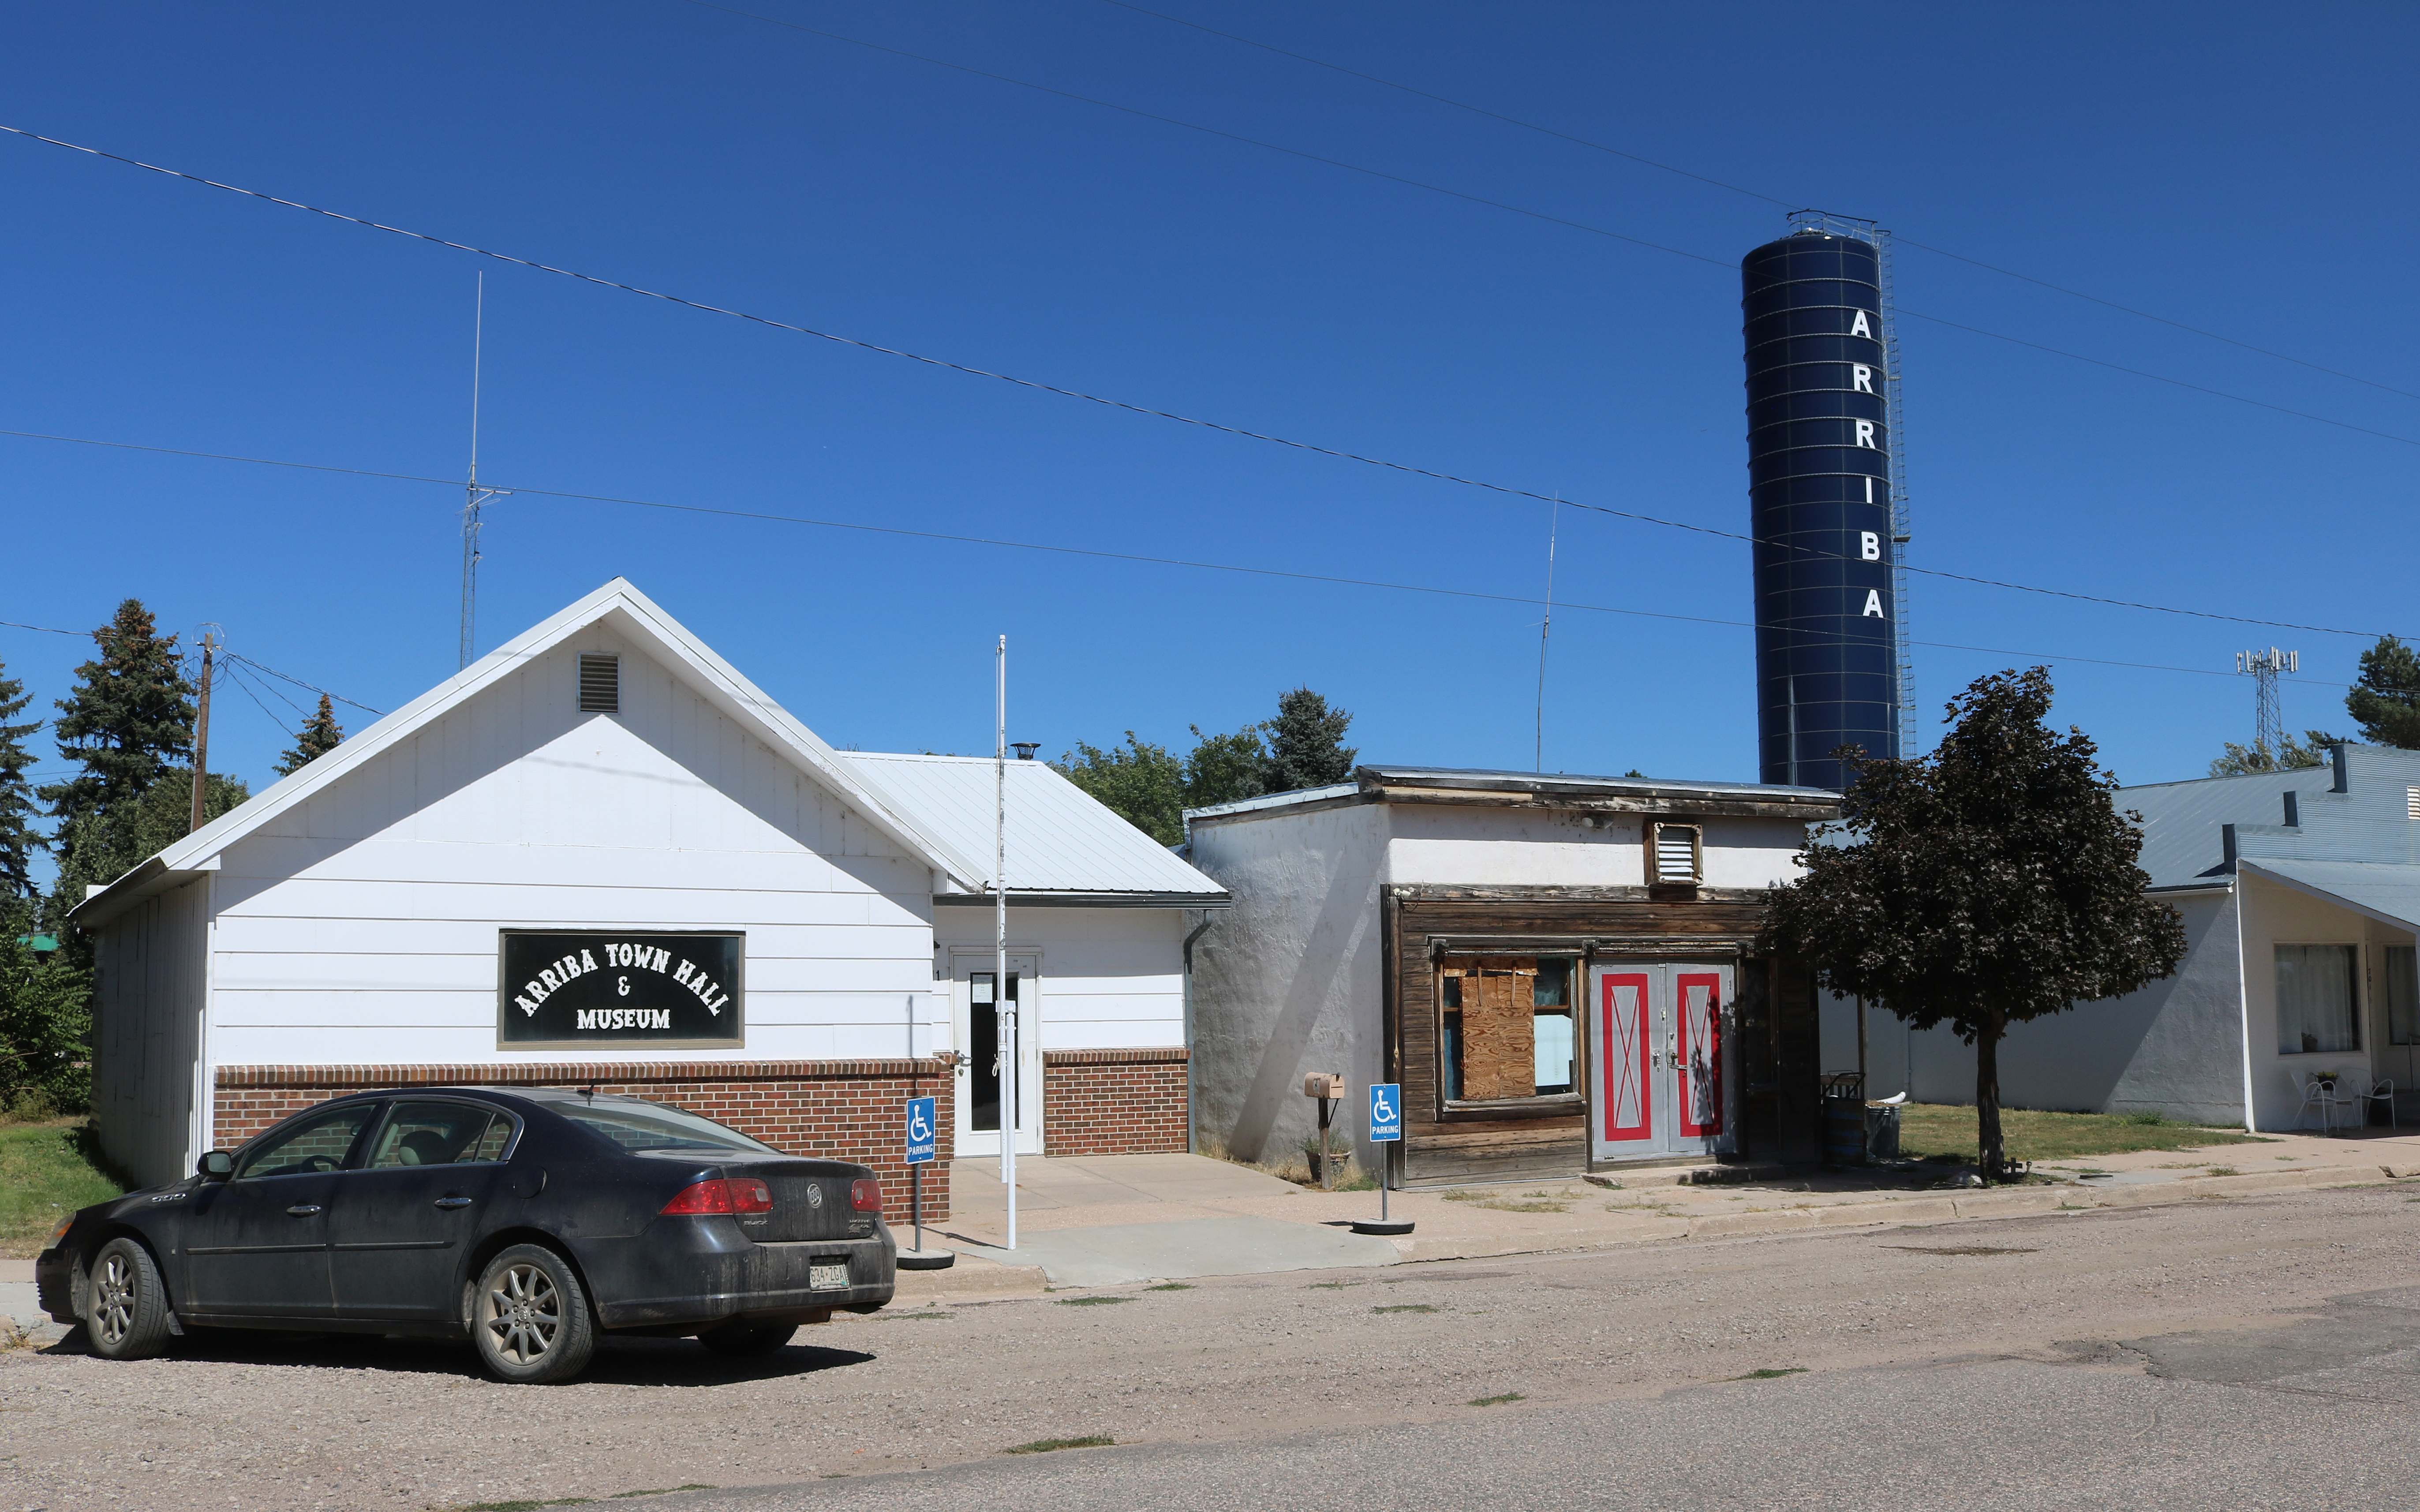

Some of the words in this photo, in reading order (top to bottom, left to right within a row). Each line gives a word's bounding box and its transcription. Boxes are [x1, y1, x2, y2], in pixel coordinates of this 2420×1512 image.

[1851, 310, 1884, 618] ARRIBA
[514, 949, 598, 1017] ARRIBA
[605, 943, 671, 974] TOWN
[673, 959, 729, 1017] HALL
[618, 976, 631, 996] &
[576, 1009, 670, 1030] MUSEUM
[1372, 1125, 1399, 1135] PARKING
[908, 1143, 933, 1156] PARKING
